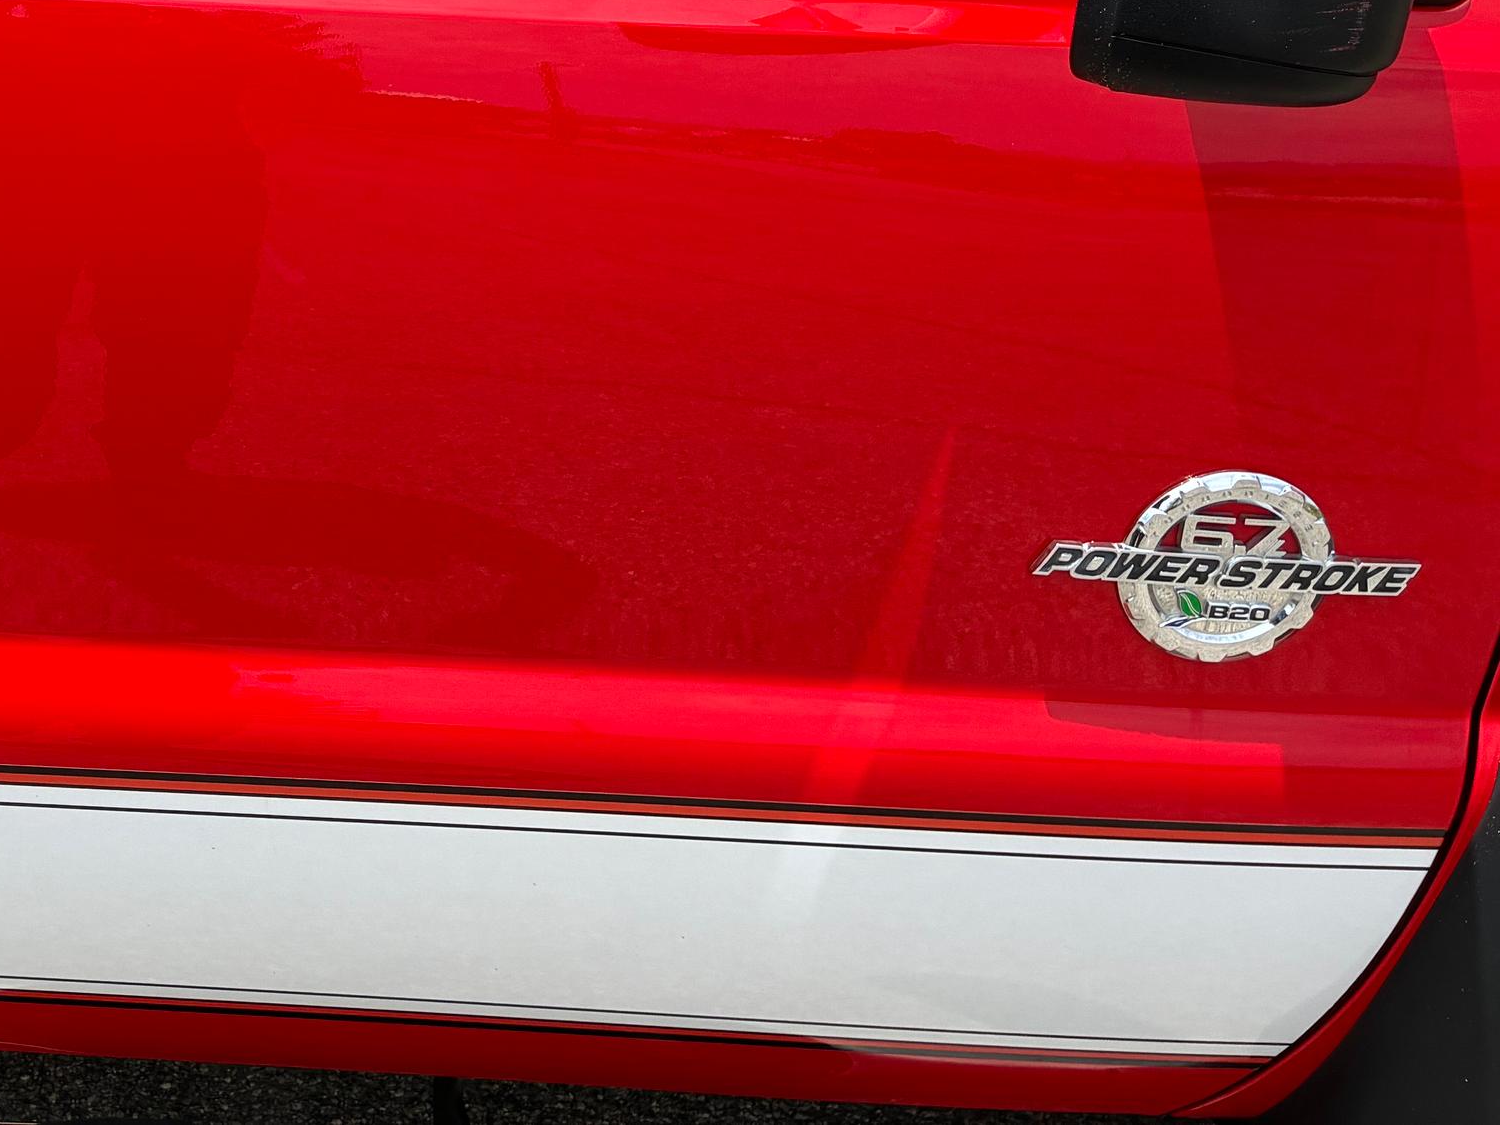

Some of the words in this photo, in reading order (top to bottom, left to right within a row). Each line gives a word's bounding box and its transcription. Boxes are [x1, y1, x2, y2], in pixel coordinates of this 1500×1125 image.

[1038, 546, 1221, 586] POWER
[1219, 558, 1417, 594] STROKE
[1208, 604, 1271, 622] B20
